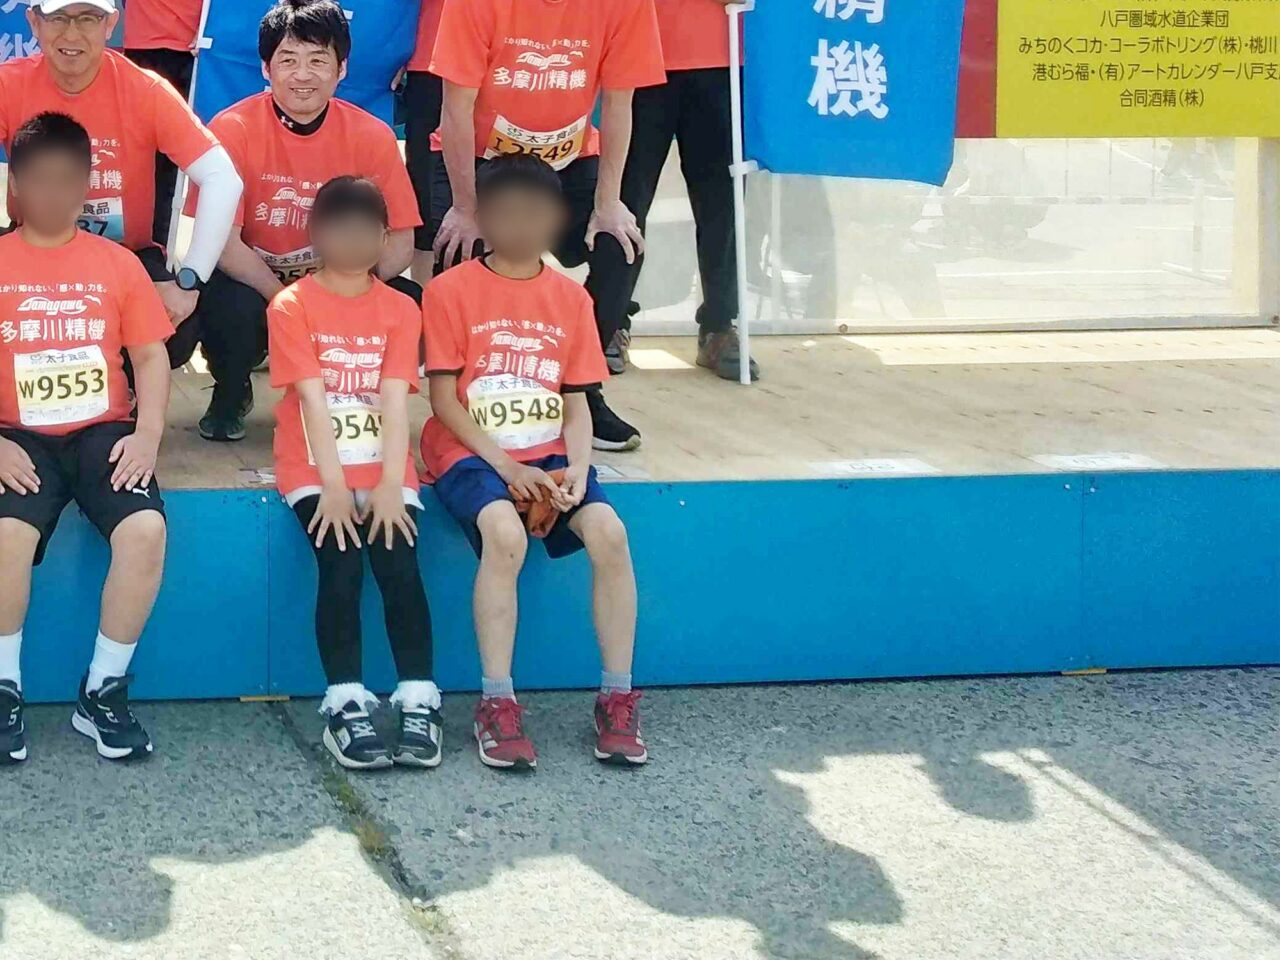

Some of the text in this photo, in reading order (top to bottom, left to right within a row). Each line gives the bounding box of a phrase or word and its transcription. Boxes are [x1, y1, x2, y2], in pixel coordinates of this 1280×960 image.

[1100, 9, 1230, 29] 八戸圏域水道企業団
[493, 66, 588, 92] 多摩川精機
[1032, 62, 1280, 82] 港むら福・(有)アートカレンダー八戸支
[1120, 89, 1205, 108] 合同酒精(株)
[16, 296, 88, 316] Tamagawa
[0, 318, 106, 344] 多摩川精機
[18, 368, 105, 401] W9553
[472, 396, 561, 428] W9548
